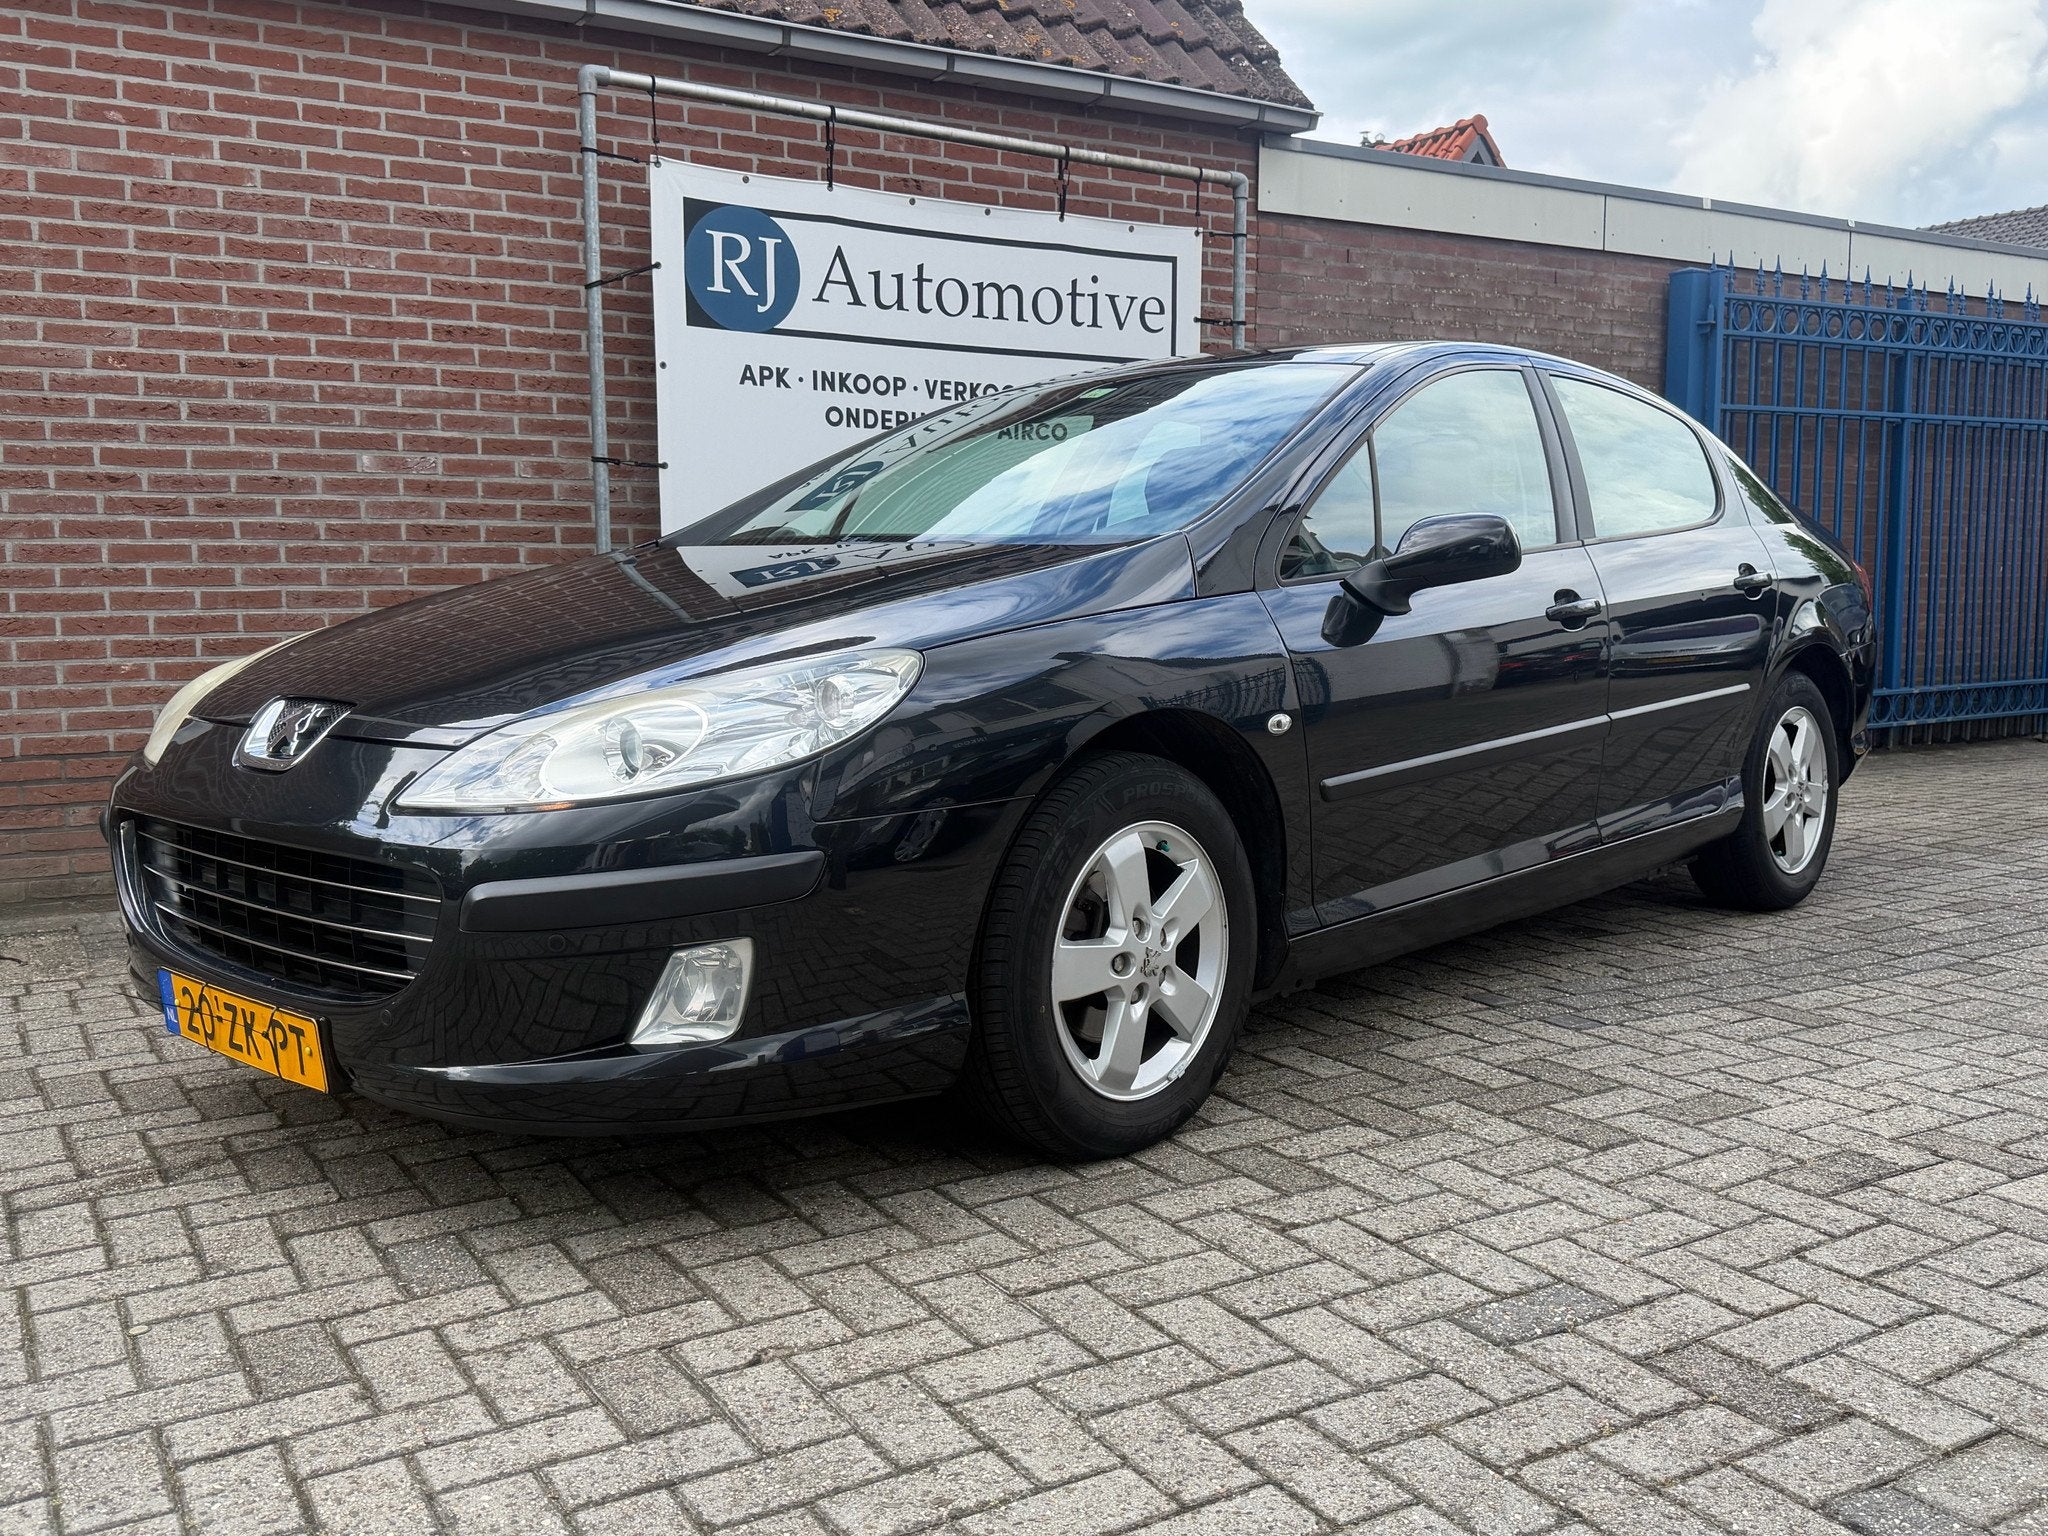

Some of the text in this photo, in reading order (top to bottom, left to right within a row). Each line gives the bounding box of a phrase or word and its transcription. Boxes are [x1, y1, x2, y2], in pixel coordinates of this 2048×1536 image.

[704, 229, 1166, 335] RJ Automotive
[739, 364, 1014, 402] APK INKOOP VERKO
[825, 406, 1068, 441] ONDER AIRCO
[166, 1006, 178, 1023] NL
